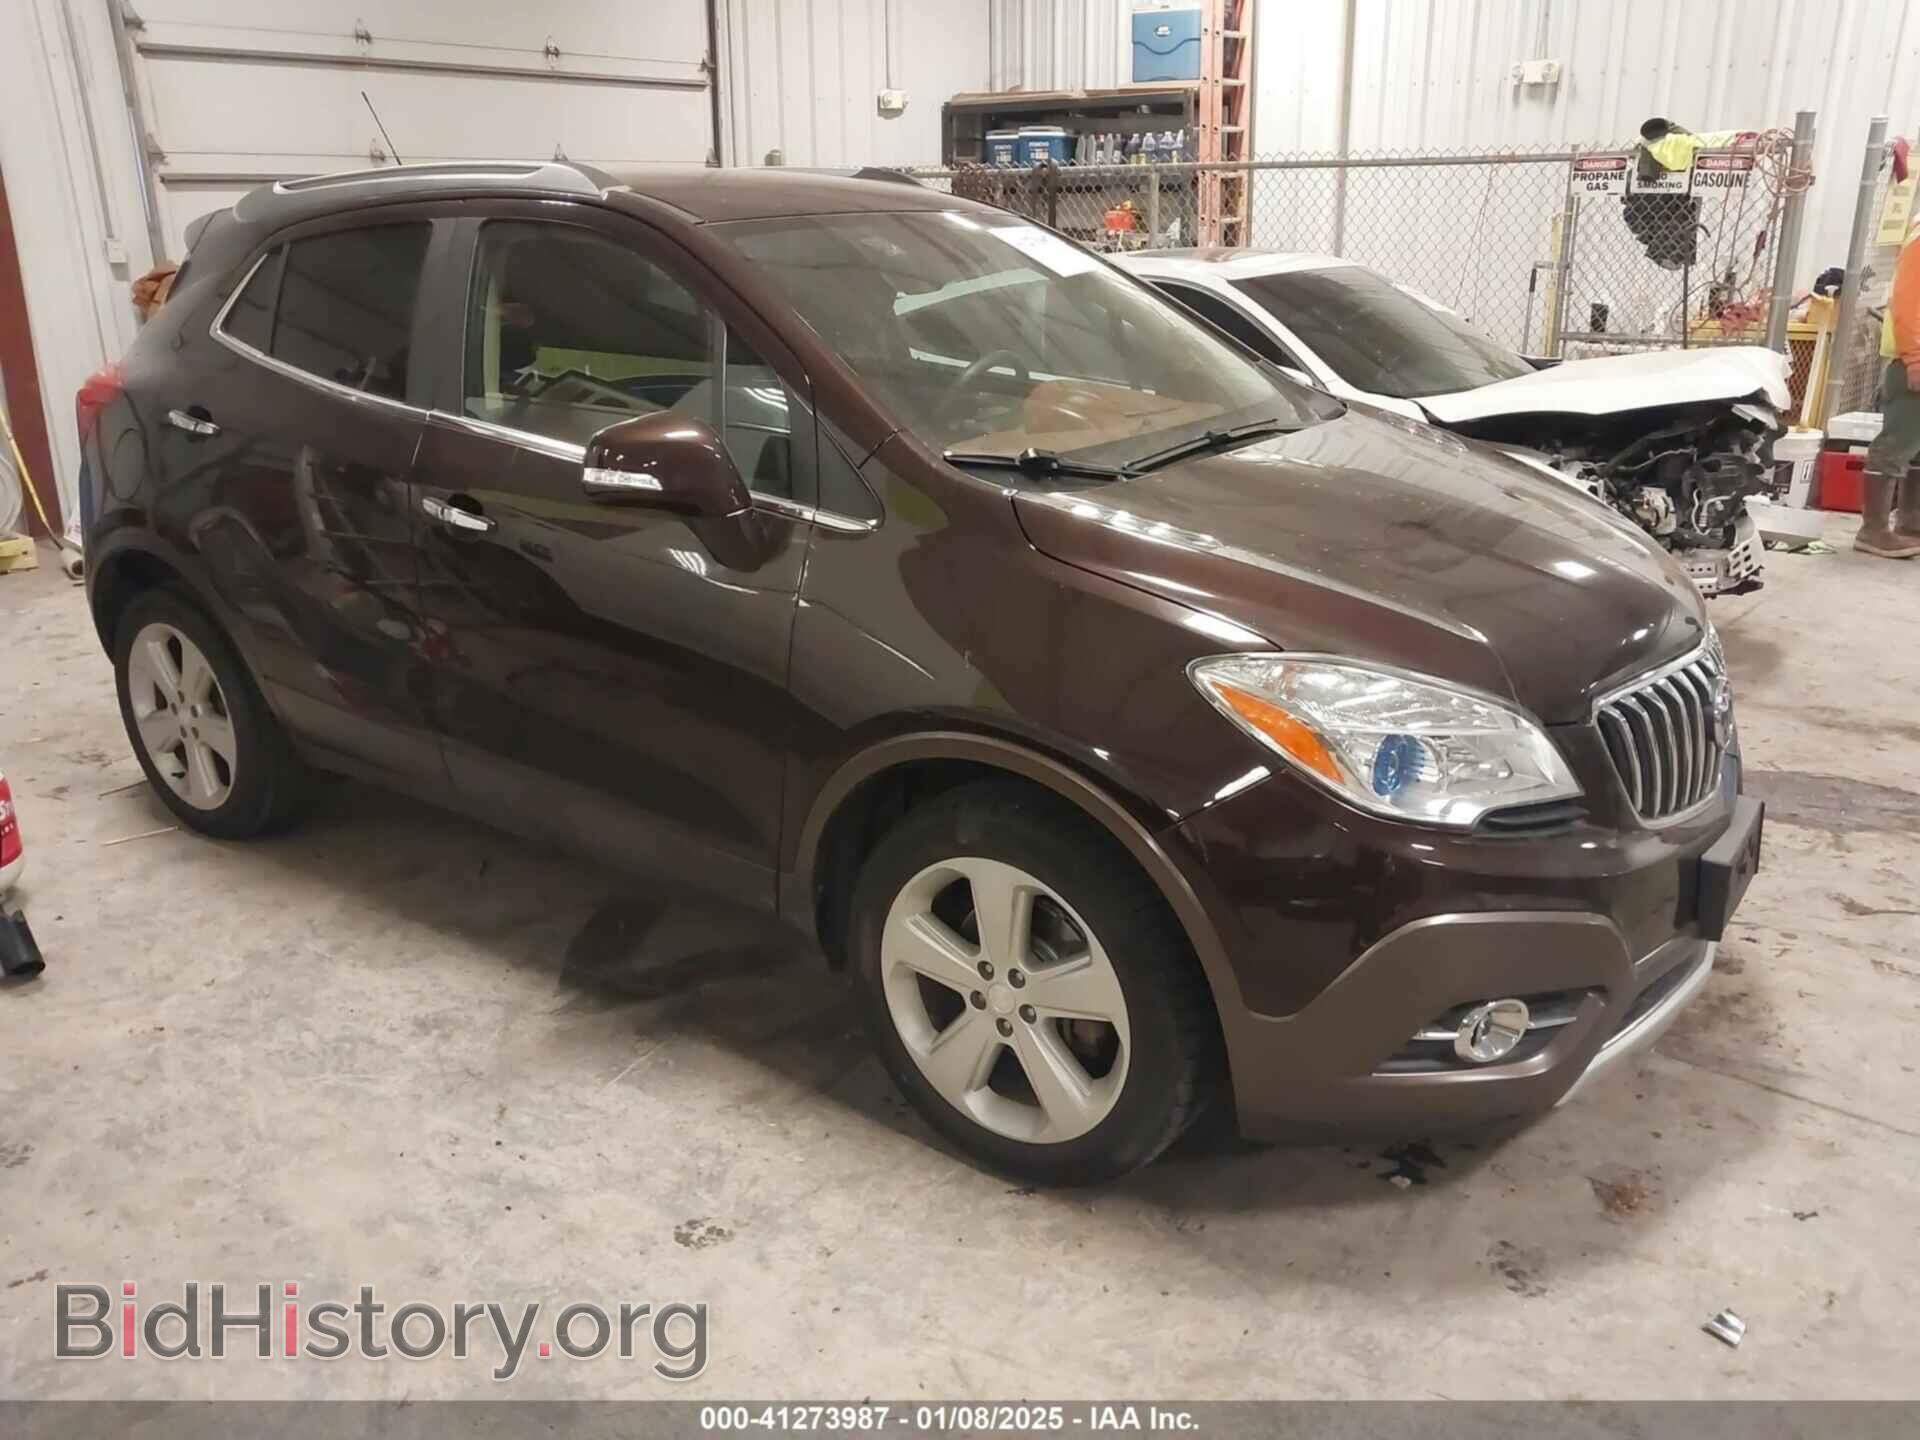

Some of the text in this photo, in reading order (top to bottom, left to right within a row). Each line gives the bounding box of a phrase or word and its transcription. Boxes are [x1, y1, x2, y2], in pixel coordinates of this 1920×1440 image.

[1582, 160, 1616, 169] DANGER
[1573, 172, 1625, 181] PROPANE
[1693, 173, 1751, 188] GASOLINE
[1586, 182, 1609, 191] GAS
[1637, 180, 1683, 189] SMOKING
